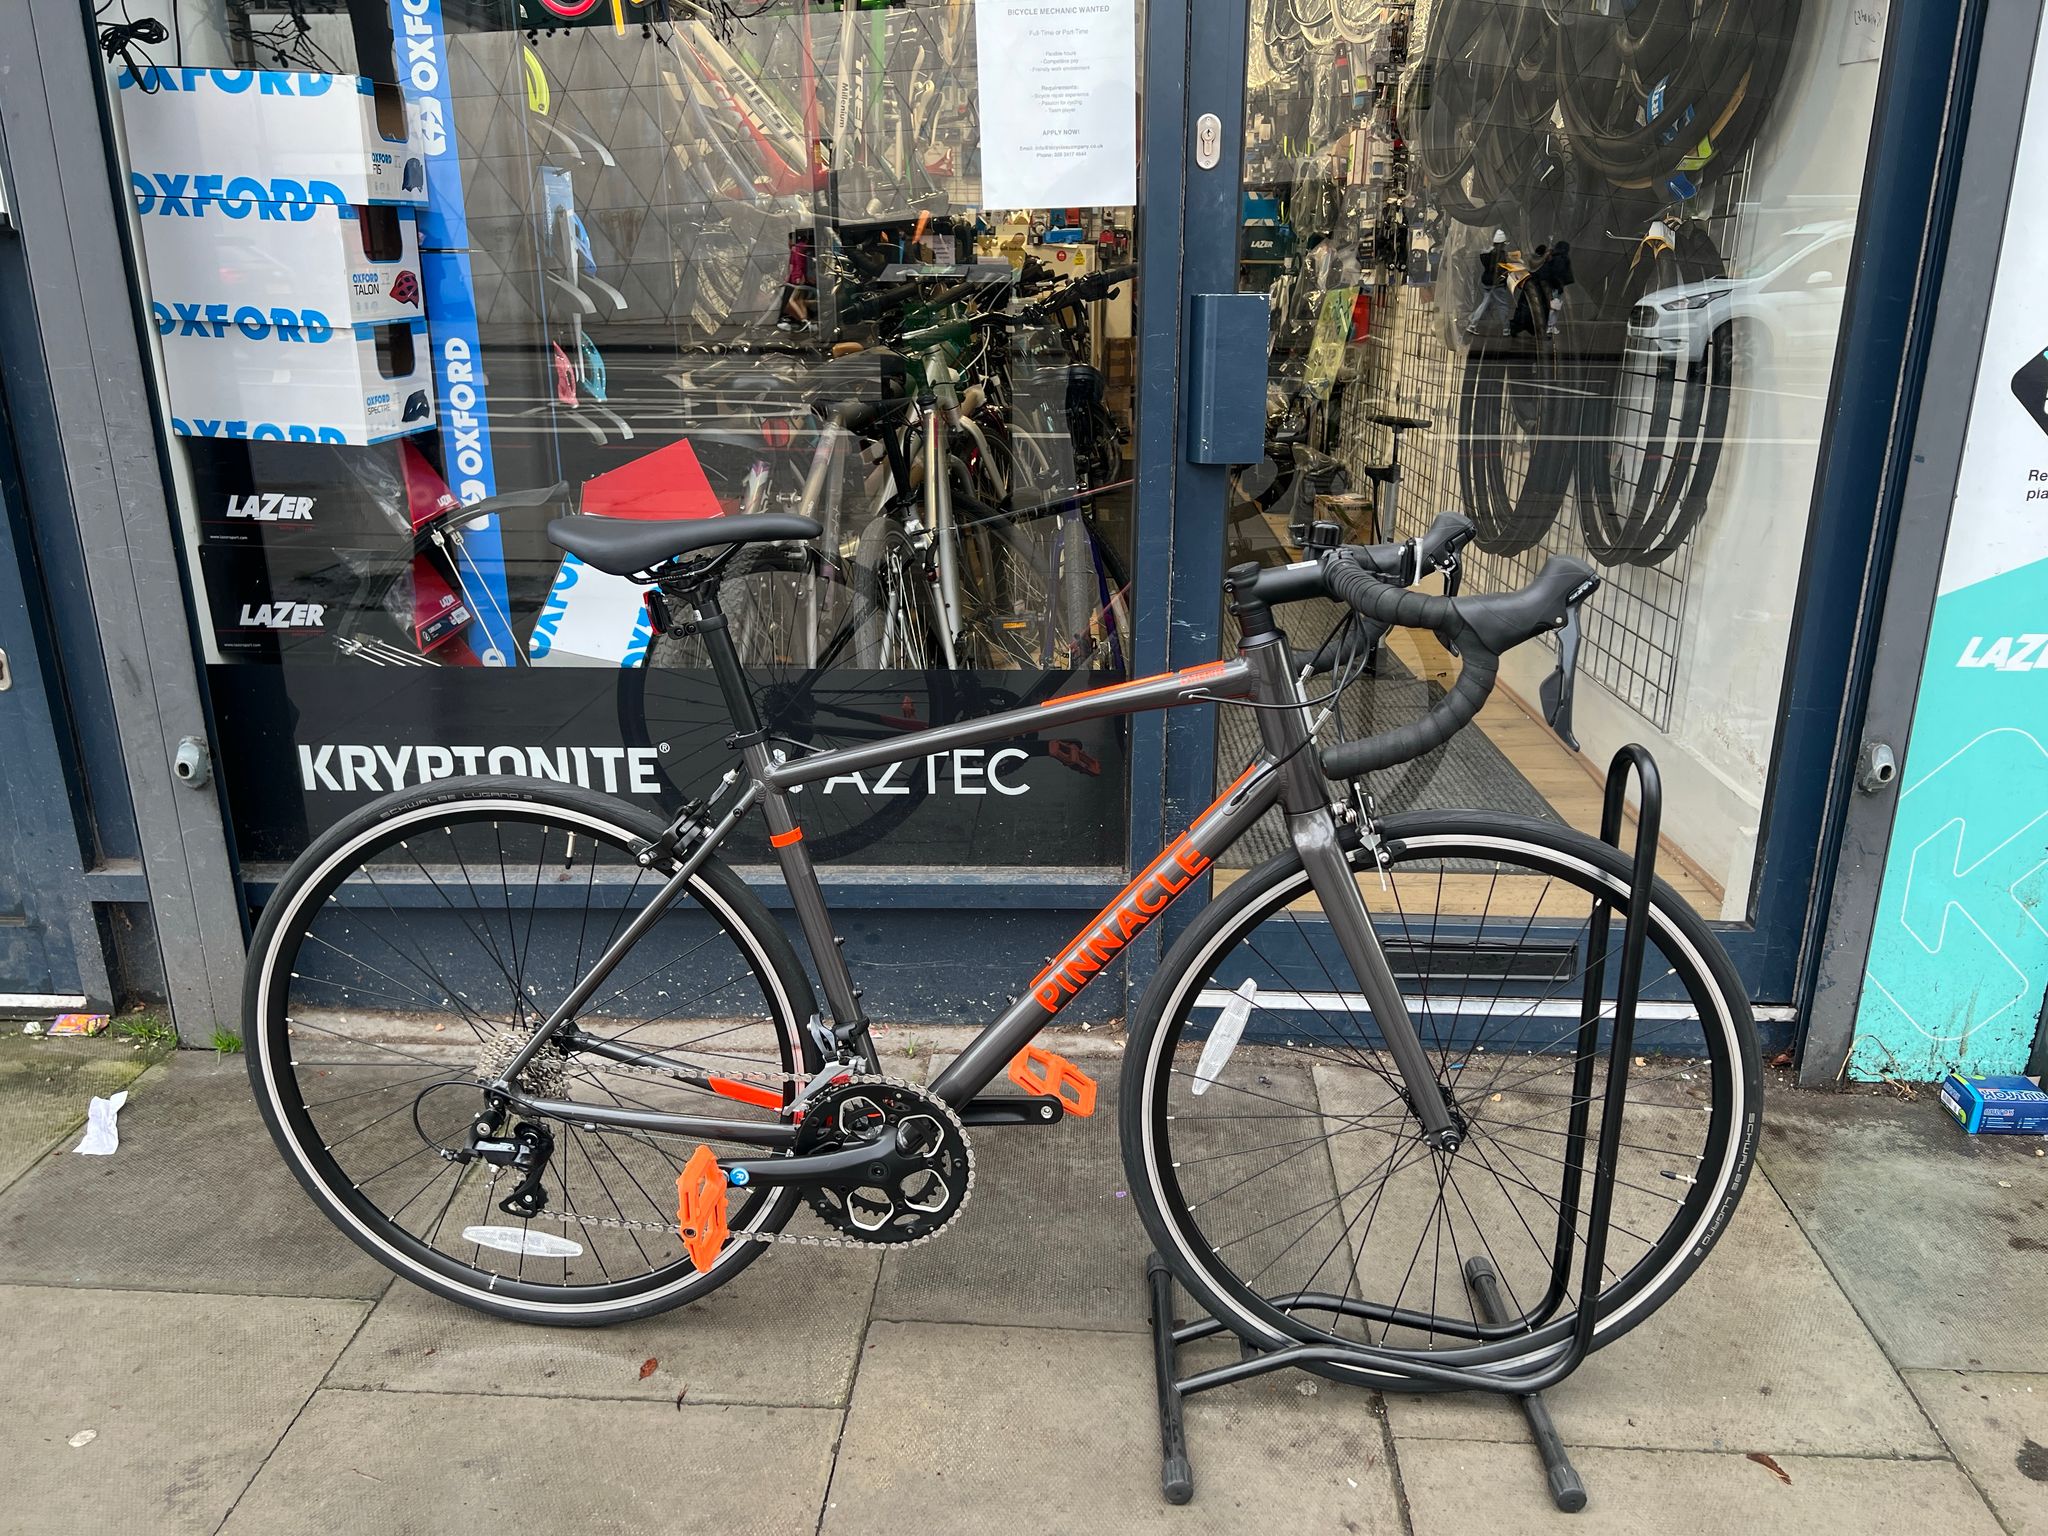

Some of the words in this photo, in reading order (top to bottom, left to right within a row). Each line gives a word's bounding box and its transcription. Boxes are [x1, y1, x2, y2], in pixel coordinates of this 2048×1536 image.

[1007, 8, 1038, 16] BICYCLE
[1039, 7, 1078, 15] MECHANIC
[1079, 5, 1110, 13] WANTED
[839, 82, 850, 129] Millenium
[855, 54, 866, 144] TREK
[372, 152, 392, 164] OXFORD
[1251, 240, 1274, 248] LAZER
[352, 272, 379, 284] OXFORD
[353, 284, 380, 296] TALON
[366, 393, 390, 406] OXFORD
[445, 337, 484, 476] OXFORD
[226, 493, 315, 521] LAZER
[239, 601, 326, 628] LAZER
[379, 794, 456, 819] SCHWALBE
[462, 791, 519, 800] LUGANO
[1032, 838, 1210, 1014] PINNACLE
[1730, 1112, 1756, 1191] SCHWALBE
[1701, 1196, 1733, 1246] LUGANO
